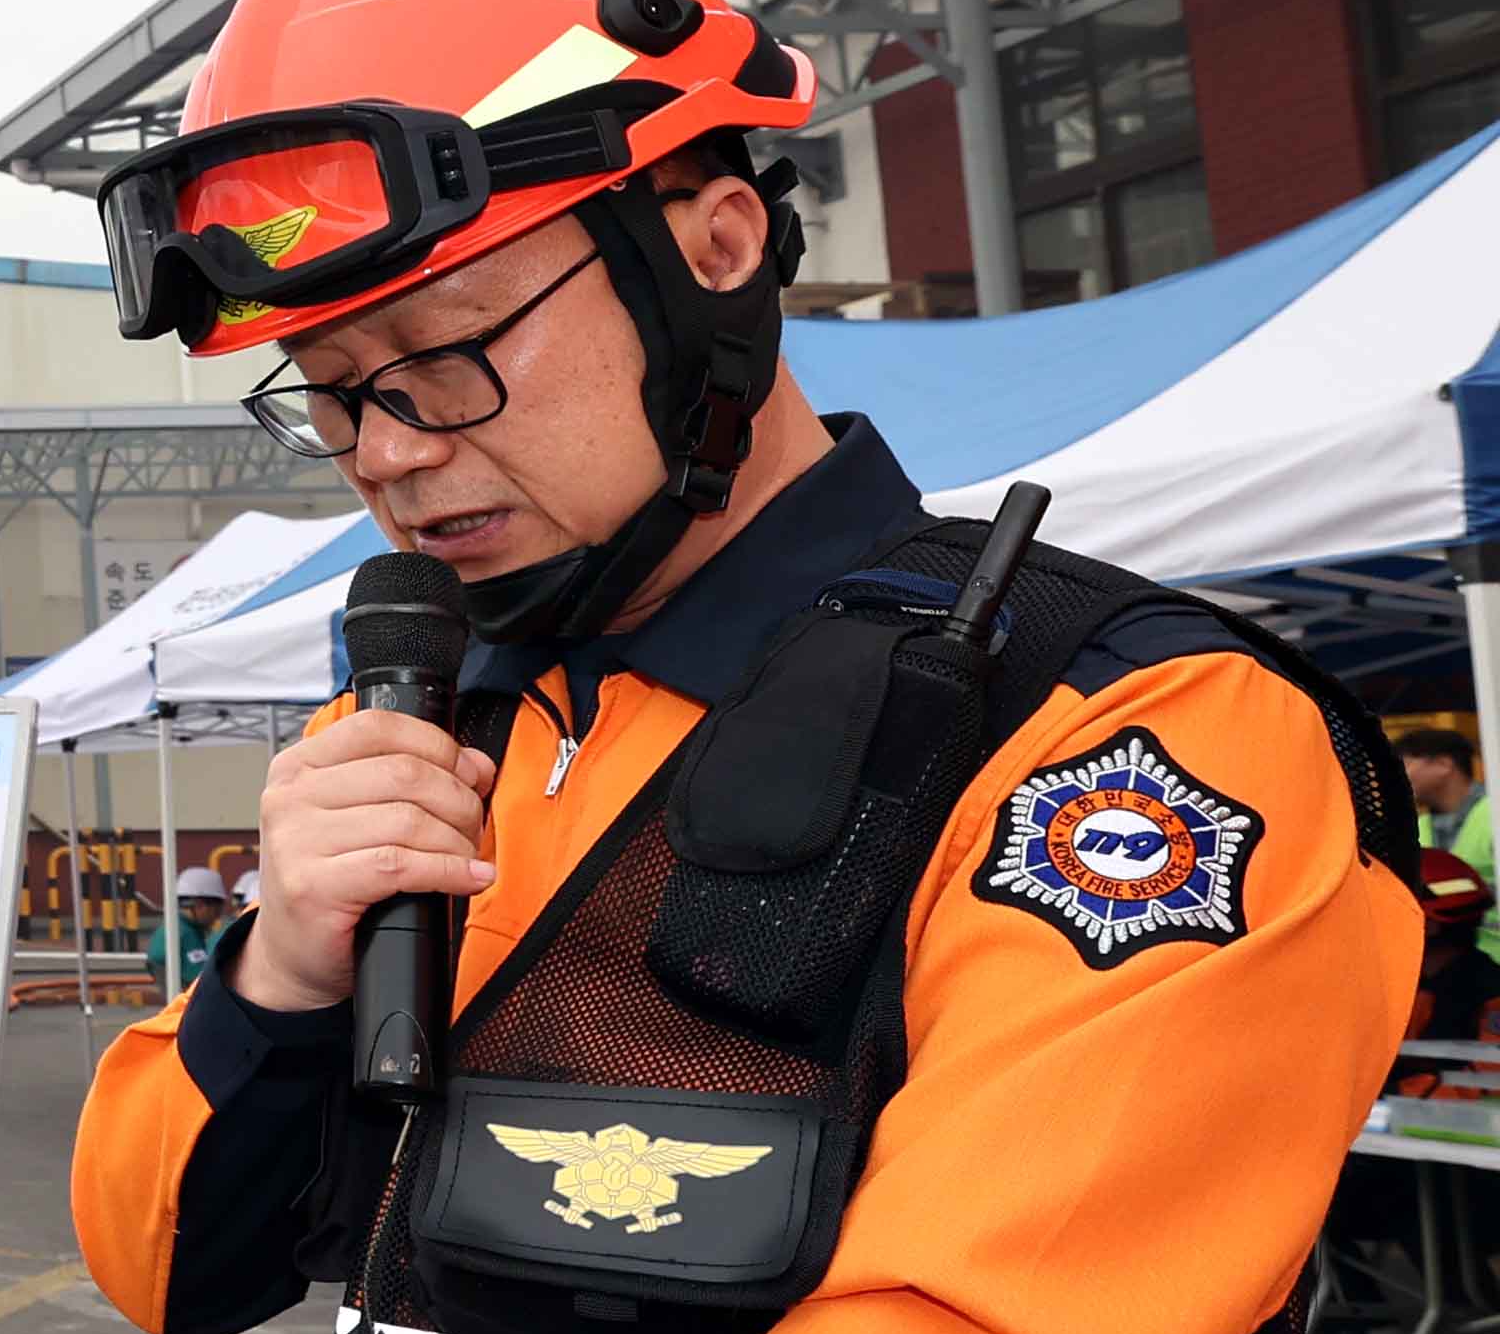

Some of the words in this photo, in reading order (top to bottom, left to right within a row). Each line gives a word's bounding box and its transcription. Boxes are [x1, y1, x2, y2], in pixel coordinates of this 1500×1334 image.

[1075, 828, 1168, 862] 119
[1051, 840, 1087, 885] KOREA
[1086, 875, 1124, 897] FIRE
[1129, 860, 1191, 897] SERVICE
